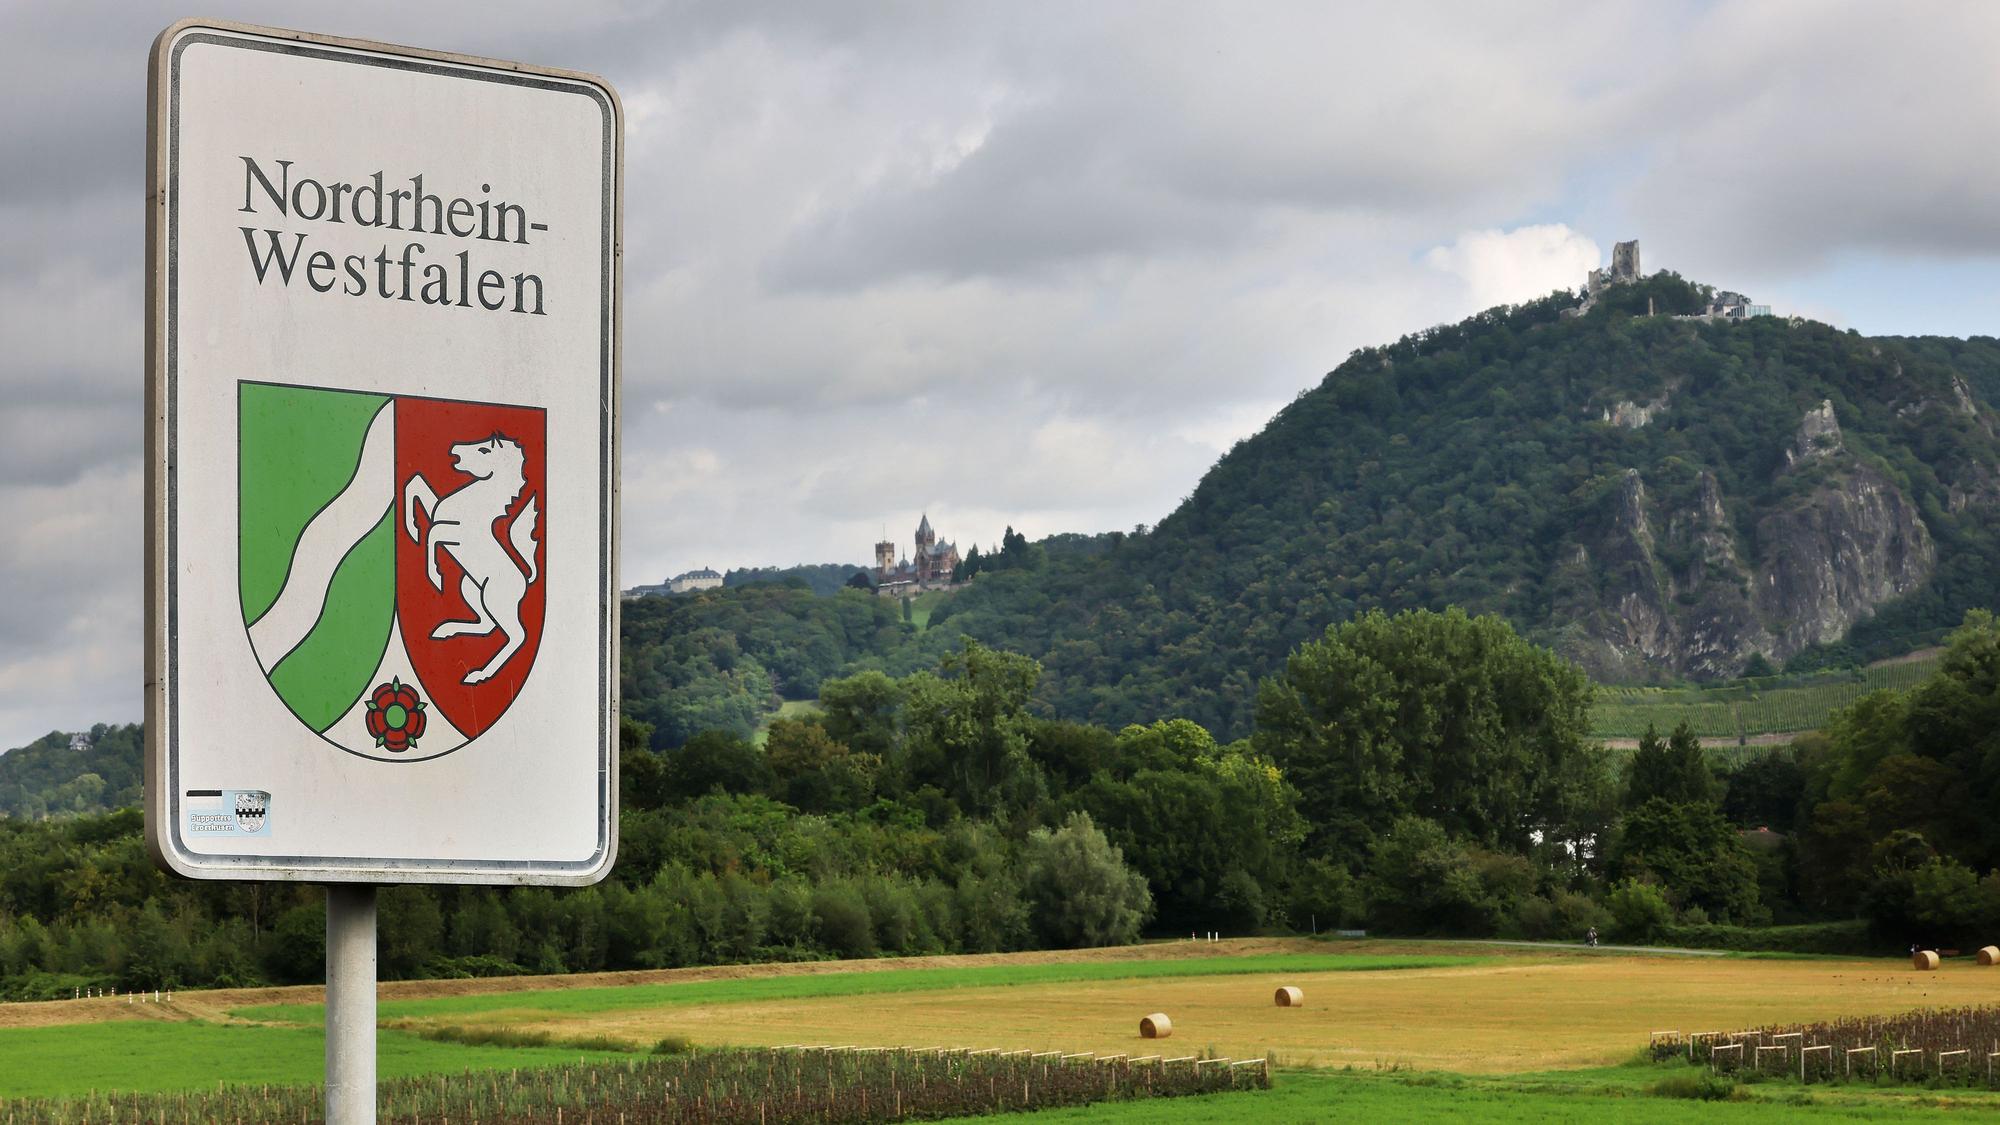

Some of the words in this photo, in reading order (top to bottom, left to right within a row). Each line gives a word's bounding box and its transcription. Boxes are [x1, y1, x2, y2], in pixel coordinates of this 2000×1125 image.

[238, 156, 548, 244] Nordrhein-
[238, 226, 547, 315] Westfalen
[191, 814, 232, 823] Supporters
